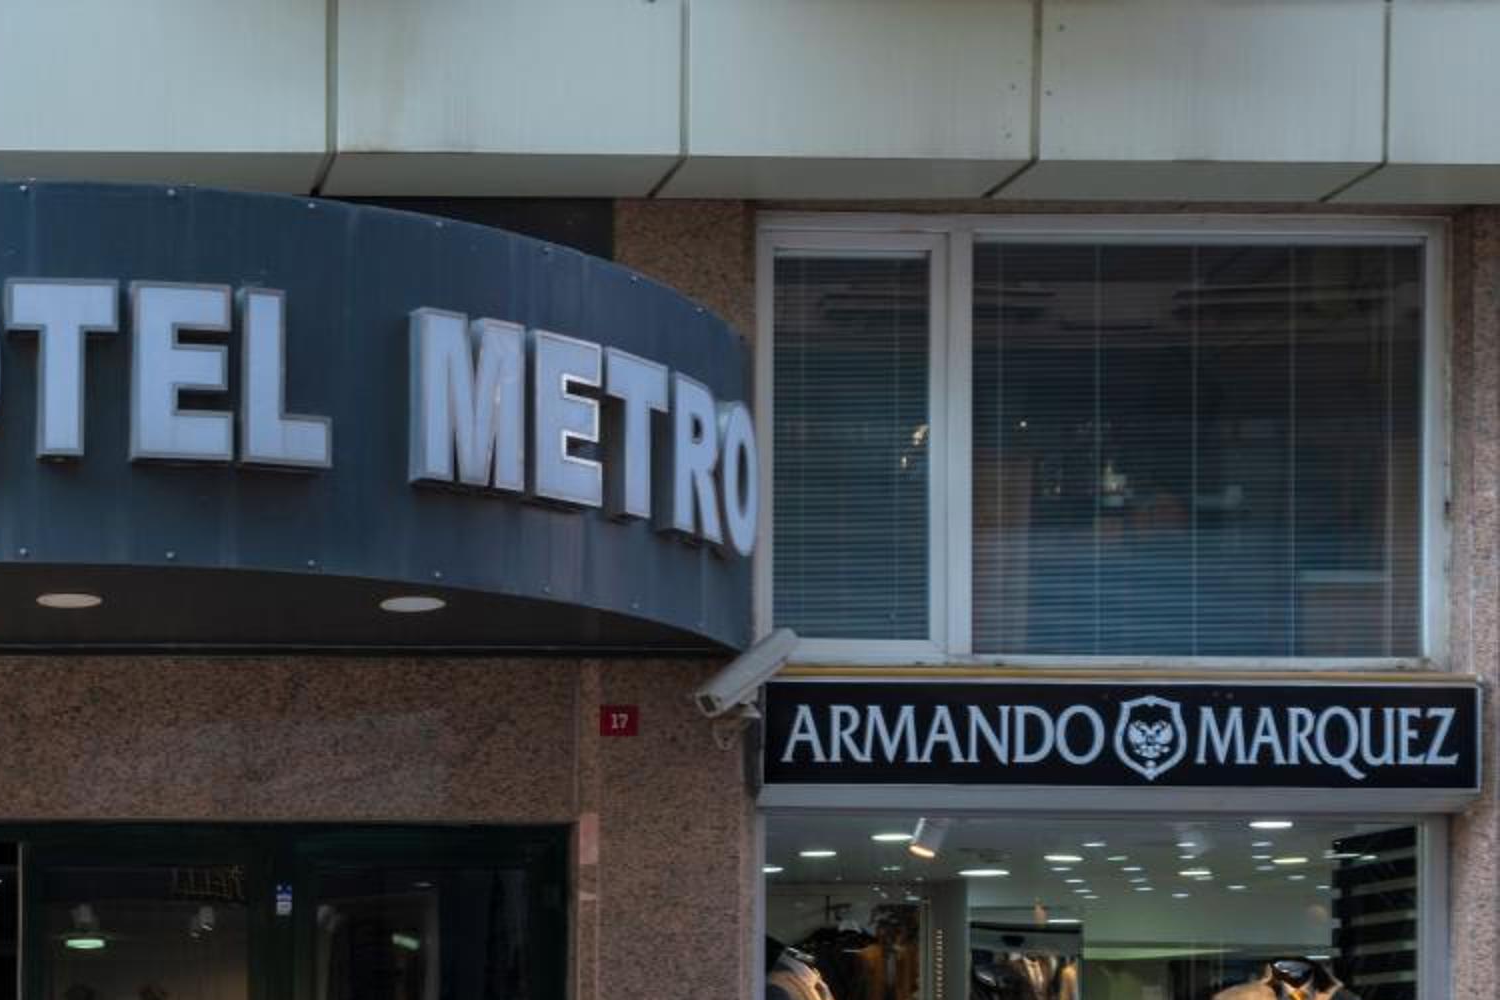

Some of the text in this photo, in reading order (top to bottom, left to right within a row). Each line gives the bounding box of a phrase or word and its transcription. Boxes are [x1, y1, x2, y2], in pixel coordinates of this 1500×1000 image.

[408, 305, 758, 558] METRO
[611, 713, 629, 729] 17
[780, 704, 1459, 780] ARMANDO MARQUEZ
